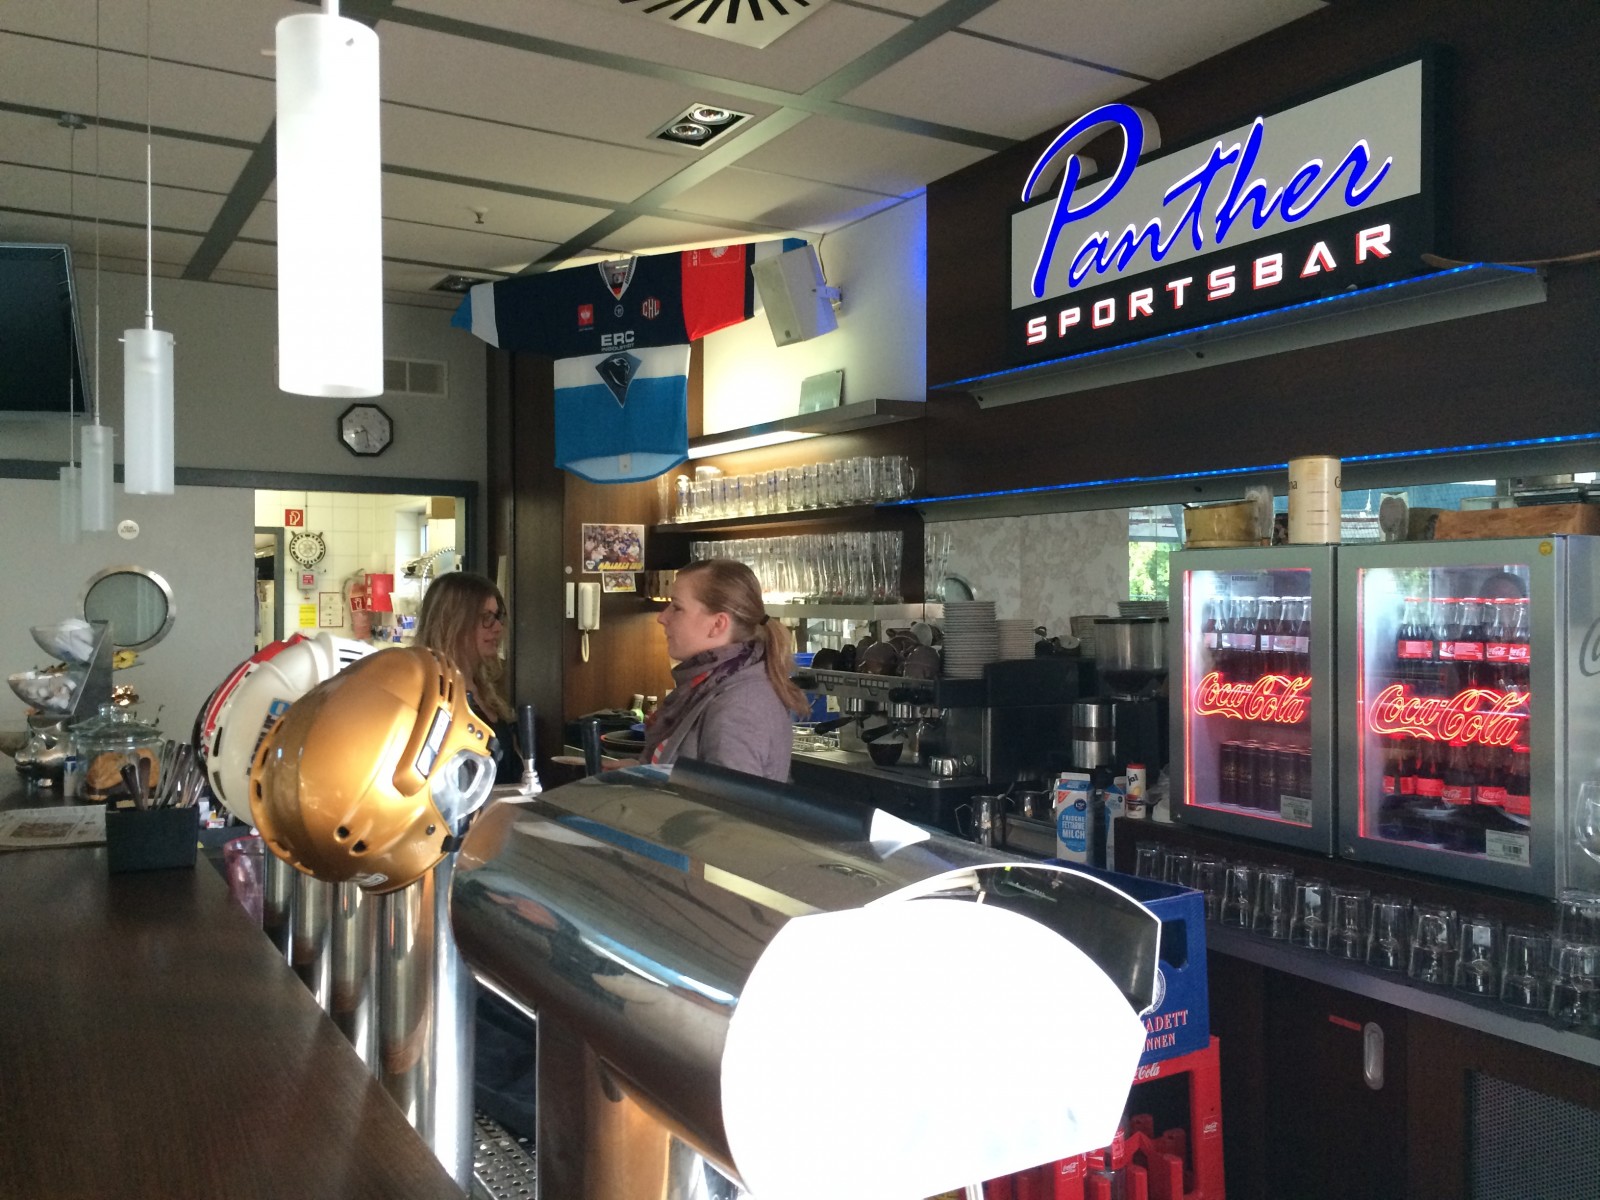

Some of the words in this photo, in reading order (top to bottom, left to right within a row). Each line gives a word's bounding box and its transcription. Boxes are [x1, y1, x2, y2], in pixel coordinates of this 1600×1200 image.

[1022, 104, 1394, 299] Panther
[1026, 223, 1392, 346] SPORTSBAR
[642, 298, 661, 319] CHL
[600, 330, 635, 347] ERC
[1193, 671, 1312, 724] Coca-Cola
[1369, 684, 1531, 746] Coca-Cola
[1127, 773, 1139, 787] ja!
[1062, 829, 1086, 840] MILCH
[1142, 1009, 1189, 1034] ADETT
